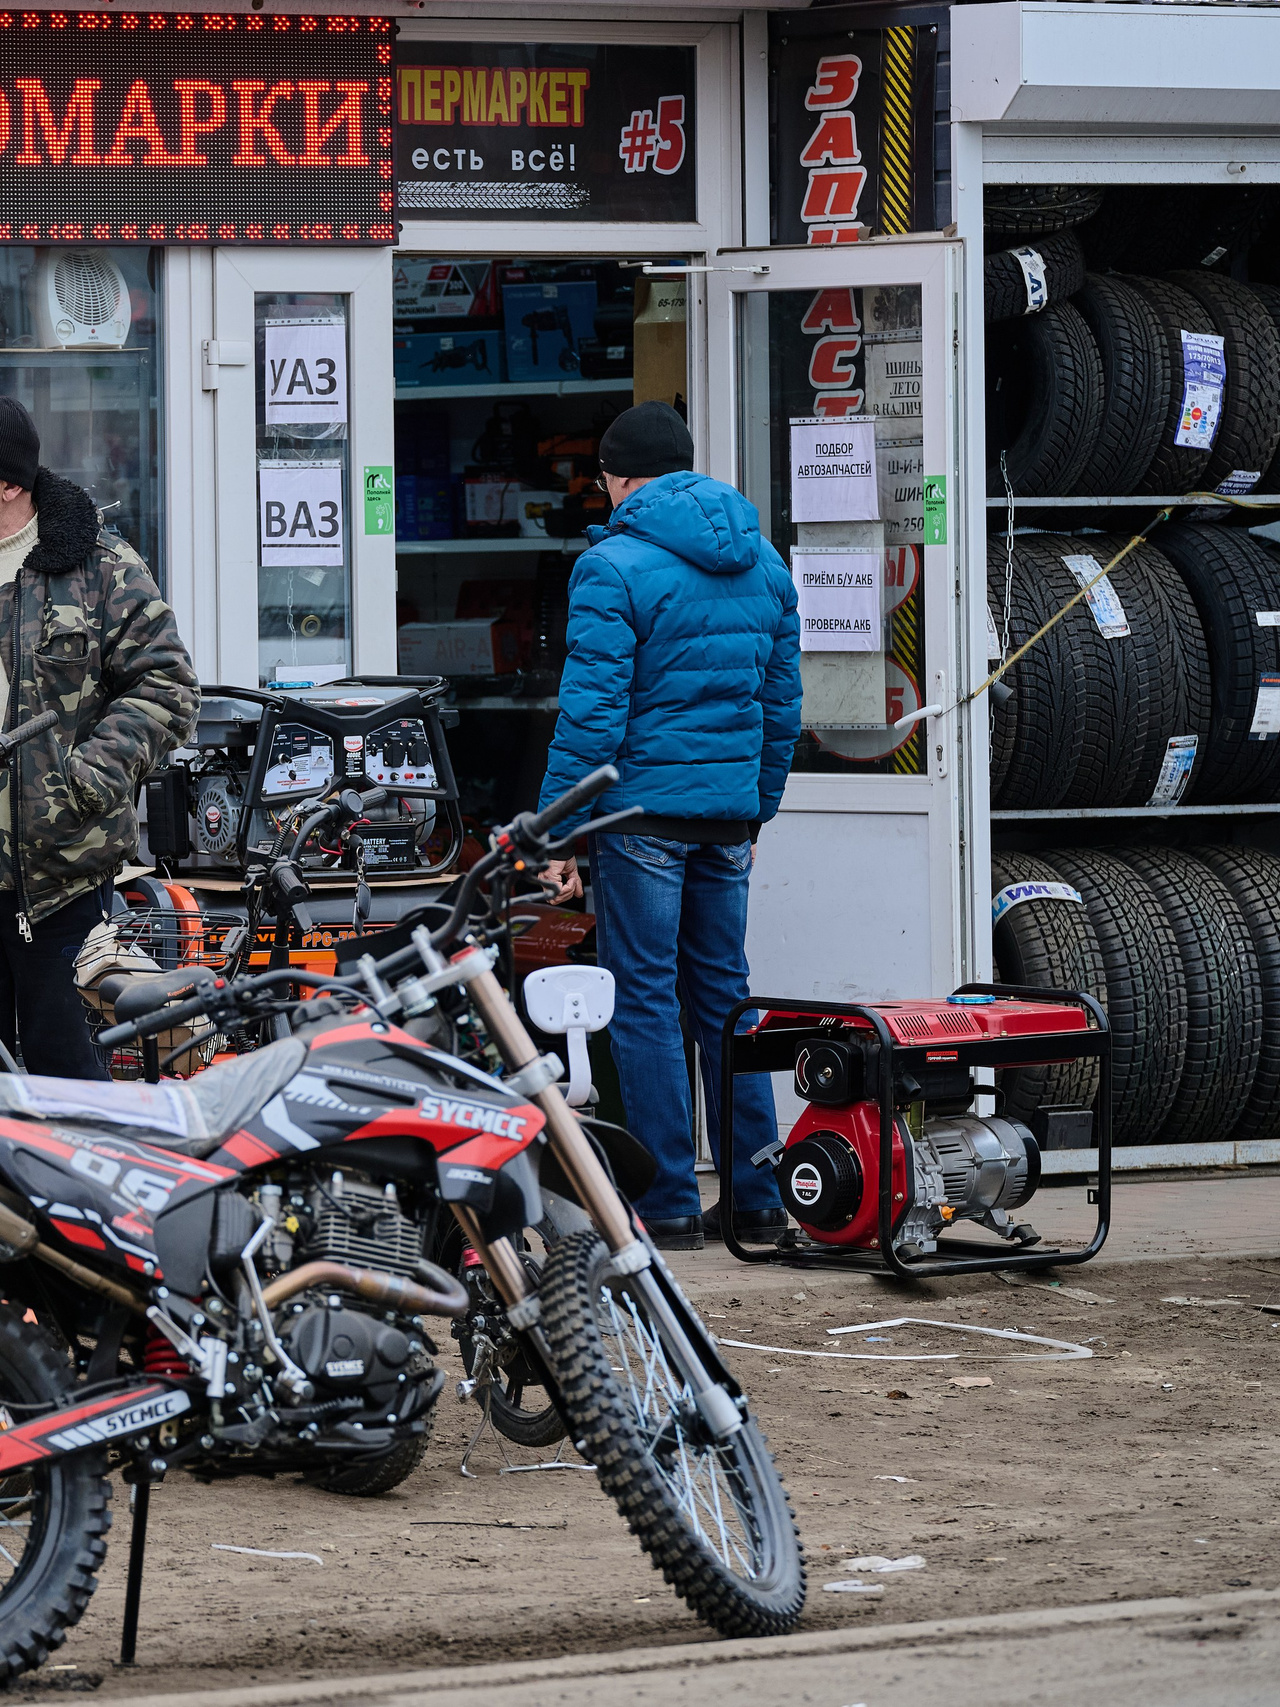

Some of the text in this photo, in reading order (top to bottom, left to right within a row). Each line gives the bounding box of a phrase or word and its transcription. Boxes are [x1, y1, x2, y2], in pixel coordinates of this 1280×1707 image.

[397, 66, 588, 126] ПЕРМАРКЕТ
[621, 95, 686, 175] #5
[411, 143, 576, 172] есть всё!
[270, 357, 338, 396] УАЗ
[889, 381, 921, 395] ЛЕТО
[815, 442, 854, 456] ПОДБОР
[797, 460, 872, 477] АВТОЗАПЧАСТЕЙ
[265, 501, 339, 538] ВАЗ
[803, 571, 873, 587] ПРИЁМ Б/У АКБ
[804, 618, 871, 631] ПРОВЕРКА АКБ
[419, 1096, 527, 1142] SYCMCC
[106, 1399, 175, 1432] SYCMCC
